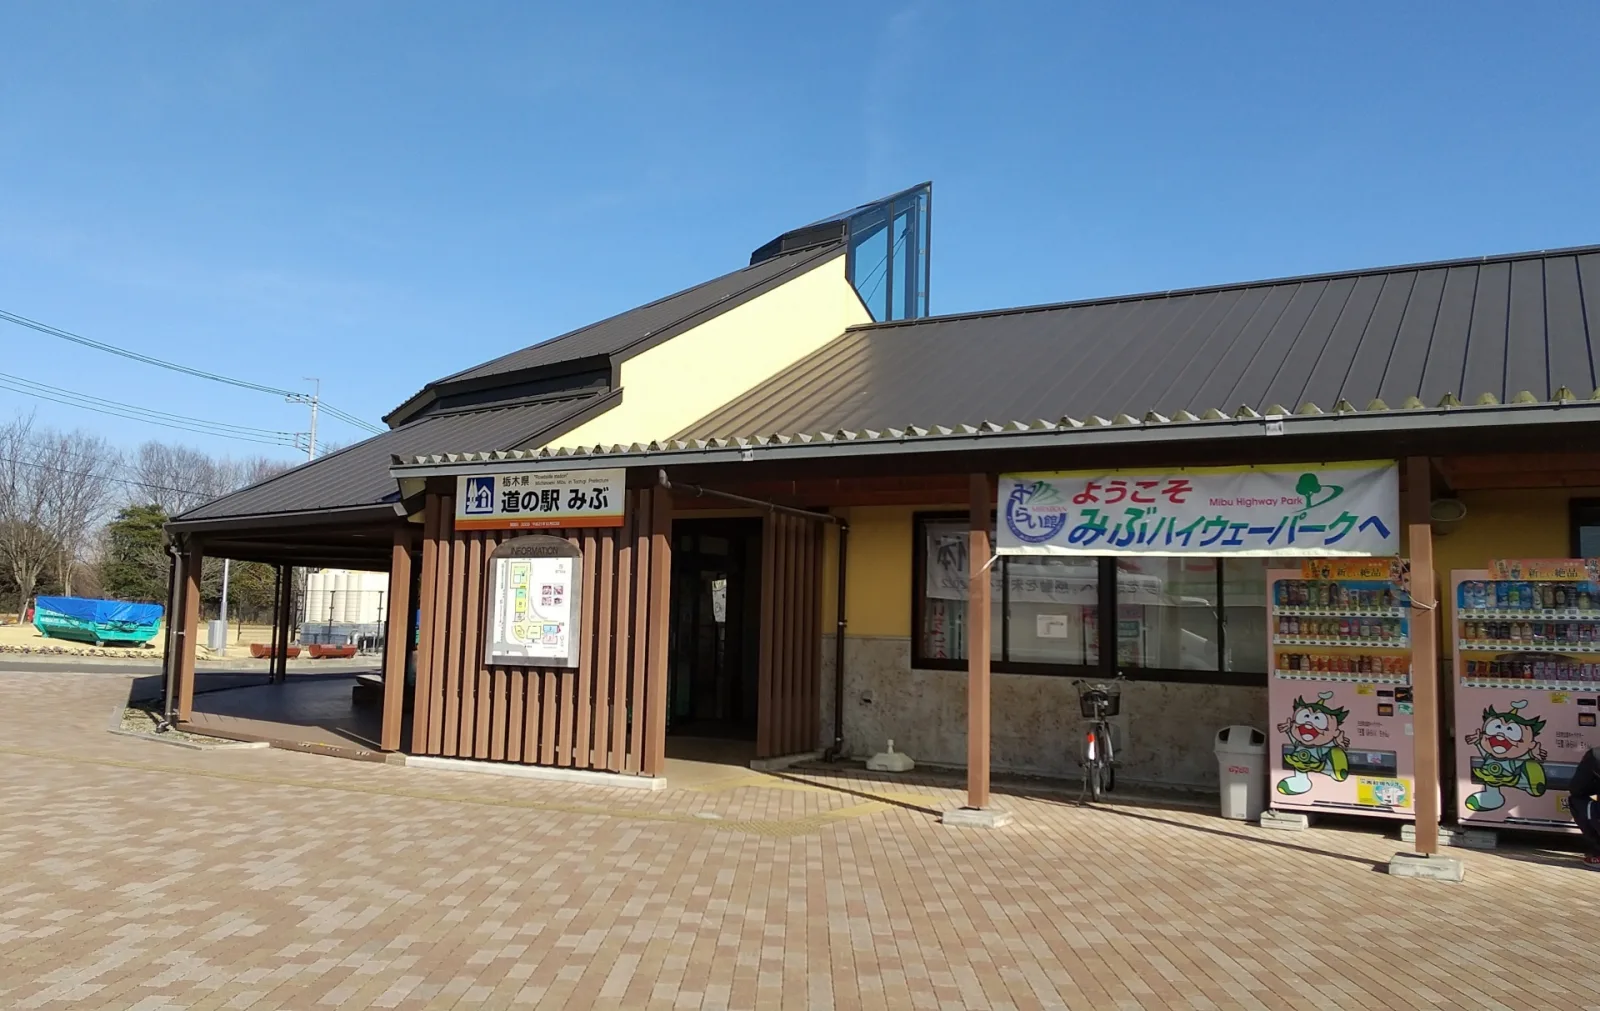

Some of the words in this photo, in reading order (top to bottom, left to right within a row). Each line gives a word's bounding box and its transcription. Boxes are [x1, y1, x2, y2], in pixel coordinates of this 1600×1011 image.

[502, 475, 530, 487] 栃木県
[501, 489, 560, 513] 道の駅
[567, 486, 610, 511] みぶ
[1073, 479, 1192, 505] ようこそ
[1210, 497, 1234, 506] Mibu
[1237, 496, 1279, 508] Highway
[1281, 495, 1303, 505] Park
[1068, 507, 1391, 547] みぶハイウェーパークへ
[511, 546, 559, 555] INFORMATION
